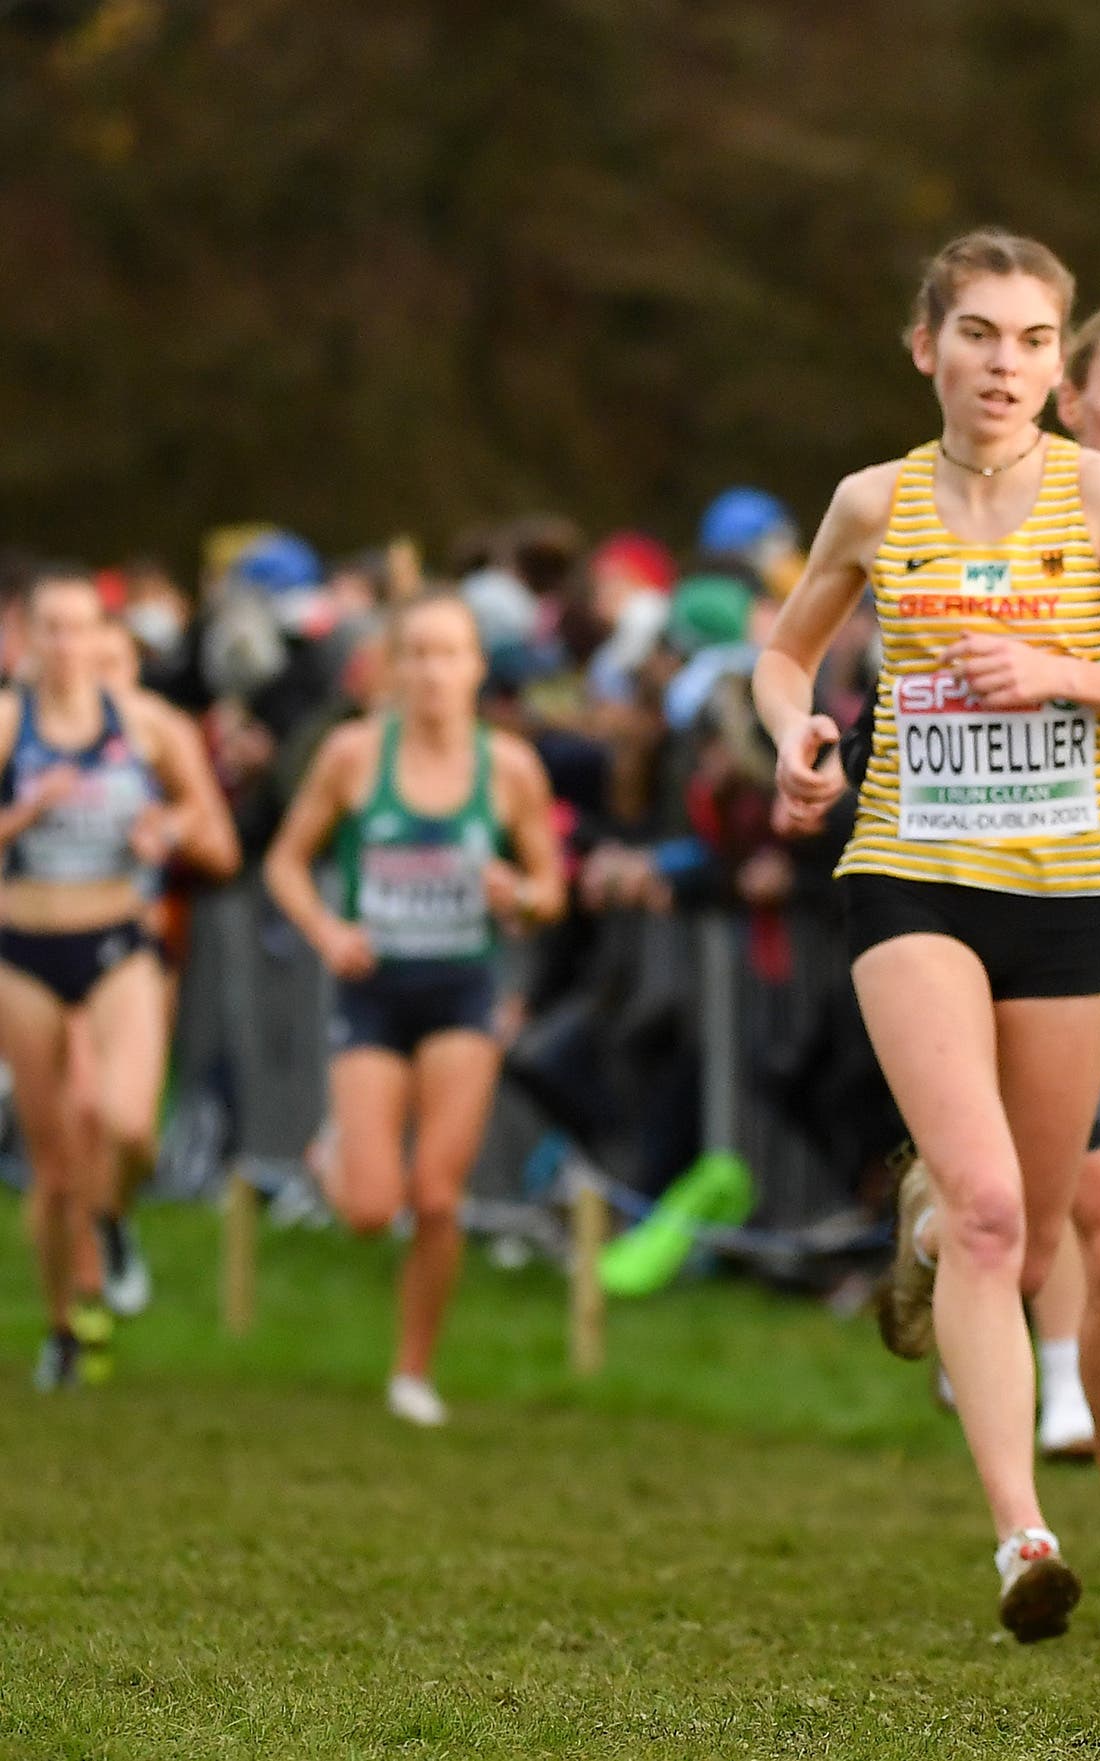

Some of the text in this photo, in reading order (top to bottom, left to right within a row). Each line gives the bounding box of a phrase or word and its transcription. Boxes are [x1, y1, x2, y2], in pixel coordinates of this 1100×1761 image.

[898, 593, 1061, 619] GERMANY
[901, 674, 982, 710] SP
[906, 718, 1086, 774] COUTELLIER
